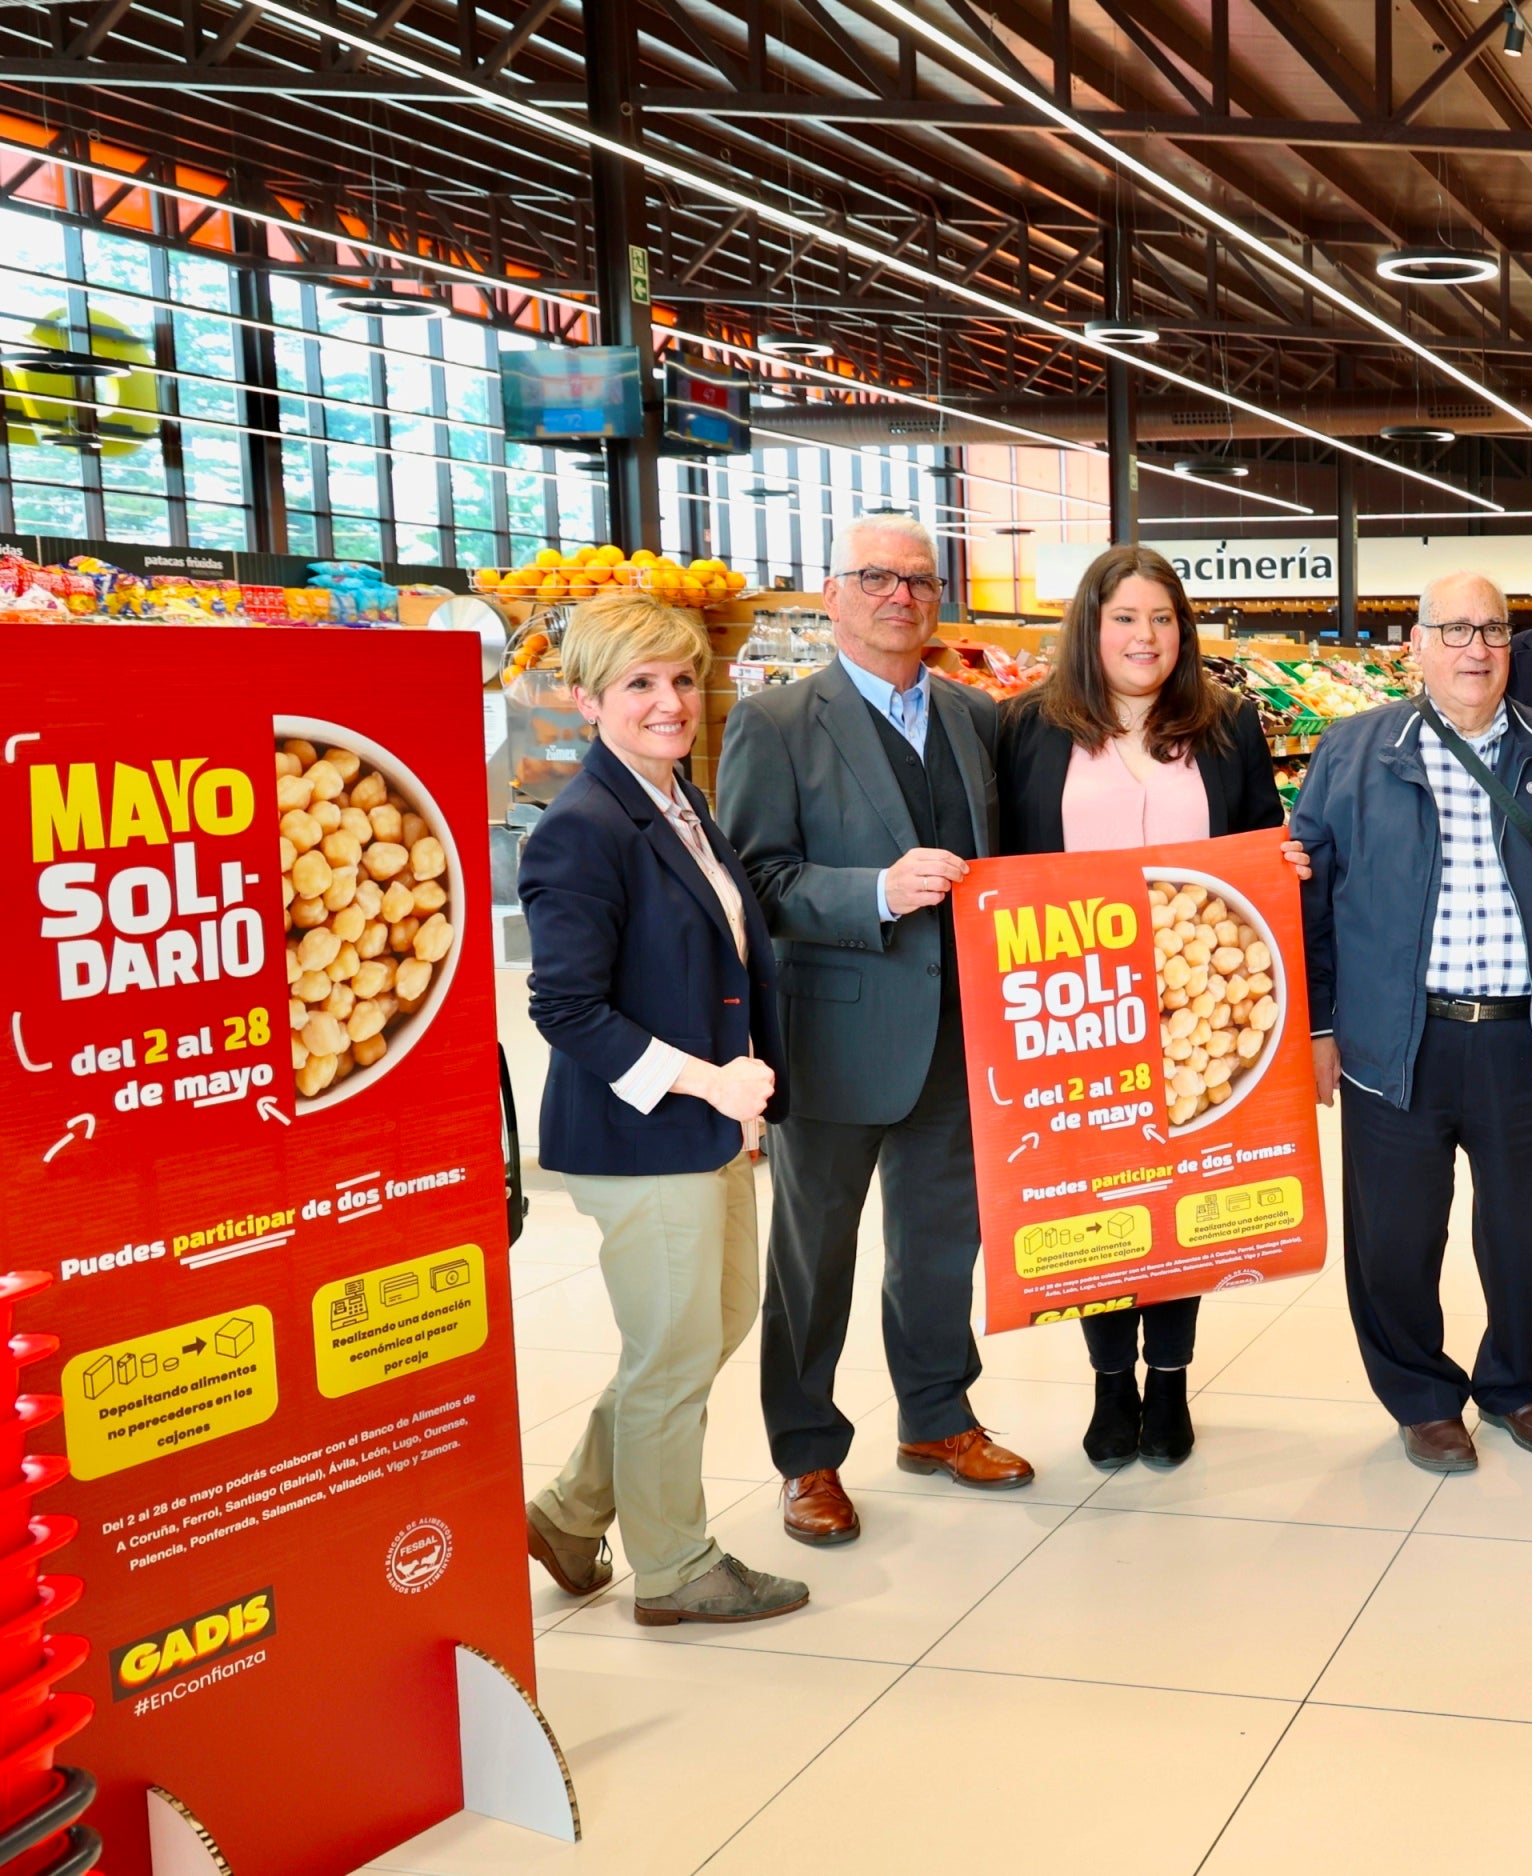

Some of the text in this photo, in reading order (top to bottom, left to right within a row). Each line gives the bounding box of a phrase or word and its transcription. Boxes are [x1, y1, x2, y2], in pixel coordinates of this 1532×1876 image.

[144, 555, 185, 568] patacas
[30, 758, 254, 862] MAYO
[38, 842, 259, 945] SOLI-
[58, 908, 264, 1000] DARIO
[994, 897, 1137, 972] MAYO
[1002, 954, 1141, 1024] SOLI-
[71, 1007, 270, 1076] del 2 al 28
[1015, 997, 1146, 1060] DARIO
[115, 1064, 273, 1111] de mayo
[1024, 1063, 1151, 1108] del 2 al 28
[1051, 1102, 1153, 1131] de mayo
[1022, 1143, 1296, 1202] Puedes participar de dos formas:
[61, 1168, 465, 1280] Puedes participar de dos formas:
[333, 1300, 471, 1349] Realizando una donación
[1035, 1296, 1134, 1326] GADIS
[350, 1322, 458, 1363] económica al pasar
[384, 1351, 428, 1375] por caja
[99, 1364, 256, 1420] Depositando alimentos
[108, 1388, 252, 1441] no perecederos en los
[103, 1395, 475, 1534] Del 2 al 28 de mayo podrás colaborar con el Banco de Alimentos de
[157, 1424, 210, 1447] cajones
[117, 1541, 126, 1553] A
[130, 1525, 179, 1547] Coruña,
[183, 1507, 222, 1528] Ferrol,
[226, 1488, 276, 1512] Santiago
[329, 1459, 358, 1474] Ávila,
[361, 1447, 390, 1462] León,
[393, 1435, 421, 1450] Lugo,
[424, 1418, 468, 1438] Ourense,
[130, 1441, 460, 1570] Palencia, Ponferrada, Salamanca, Valladolid, Vigo y Zamora.
[400, 1536, 437, 1556] FESBAL
[119, 1594, 271, 1688] GADIS
[134, 1650, 265, 1716] #EnConfianza
